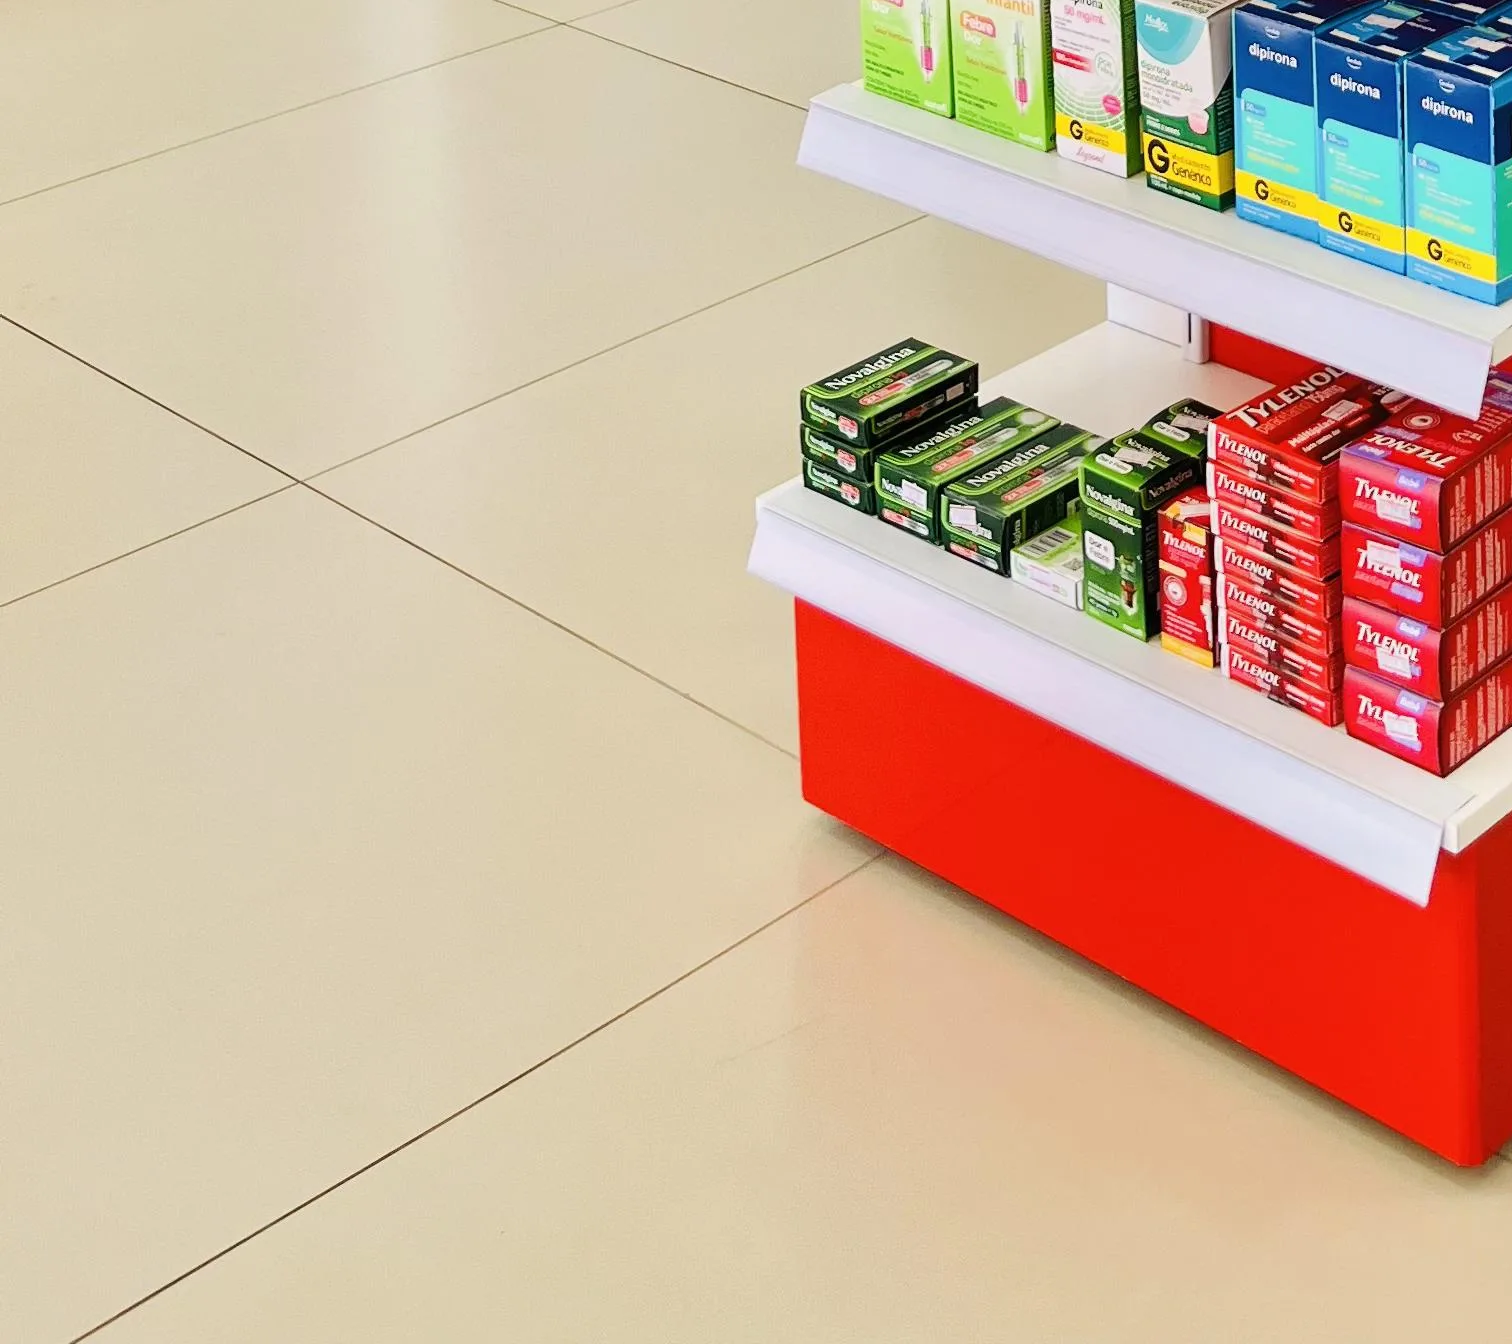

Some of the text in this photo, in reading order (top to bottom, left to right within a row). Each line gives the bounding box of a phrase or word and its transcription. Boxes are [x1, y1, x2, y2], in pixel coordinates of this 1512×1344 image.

[963, 12, 994, 35] Febre
[1249, 43, 1297, 68] dipirona
[1330, 73, 1381, 99] dipirona
[1421, 96, 1474, 124] dipirona
[1070, 119, 1083, 139] G
[1148, 139, 1170, 173] G
[1255, 180, 1269, 200] G
[1339, 211, 1352, 232] G
[1428, 238, 1442, 260] G
[825, 346, 917, 390] Novalgina
[1226, 367, 1346, 428] TYLENOL
[900, 414, 984, 457] Novalgina
[1218, 432, 1268, 465] TYLENOL
[1367, 433, 1456, 469] TYLENOL
[966, 443, 1050, 488] Novalgina
[1086, 484, 1135, 516] Novalgina
[1217, 472, 1267, 504] TYLENOL
[1220, 511, 1269, 542] TYLENOL
[1161, 531, 1207, 558] TYLENOL
[1224, 546, 1273, 581] TYLENOL
[1227, 582, 1276, 616] TYLENOL
[1228, 618, 1277, 651] TYLENOL
[1357, 621, 1420, 662] TYLENOL
[1231, 653, 1280, 687] TYLENOL
